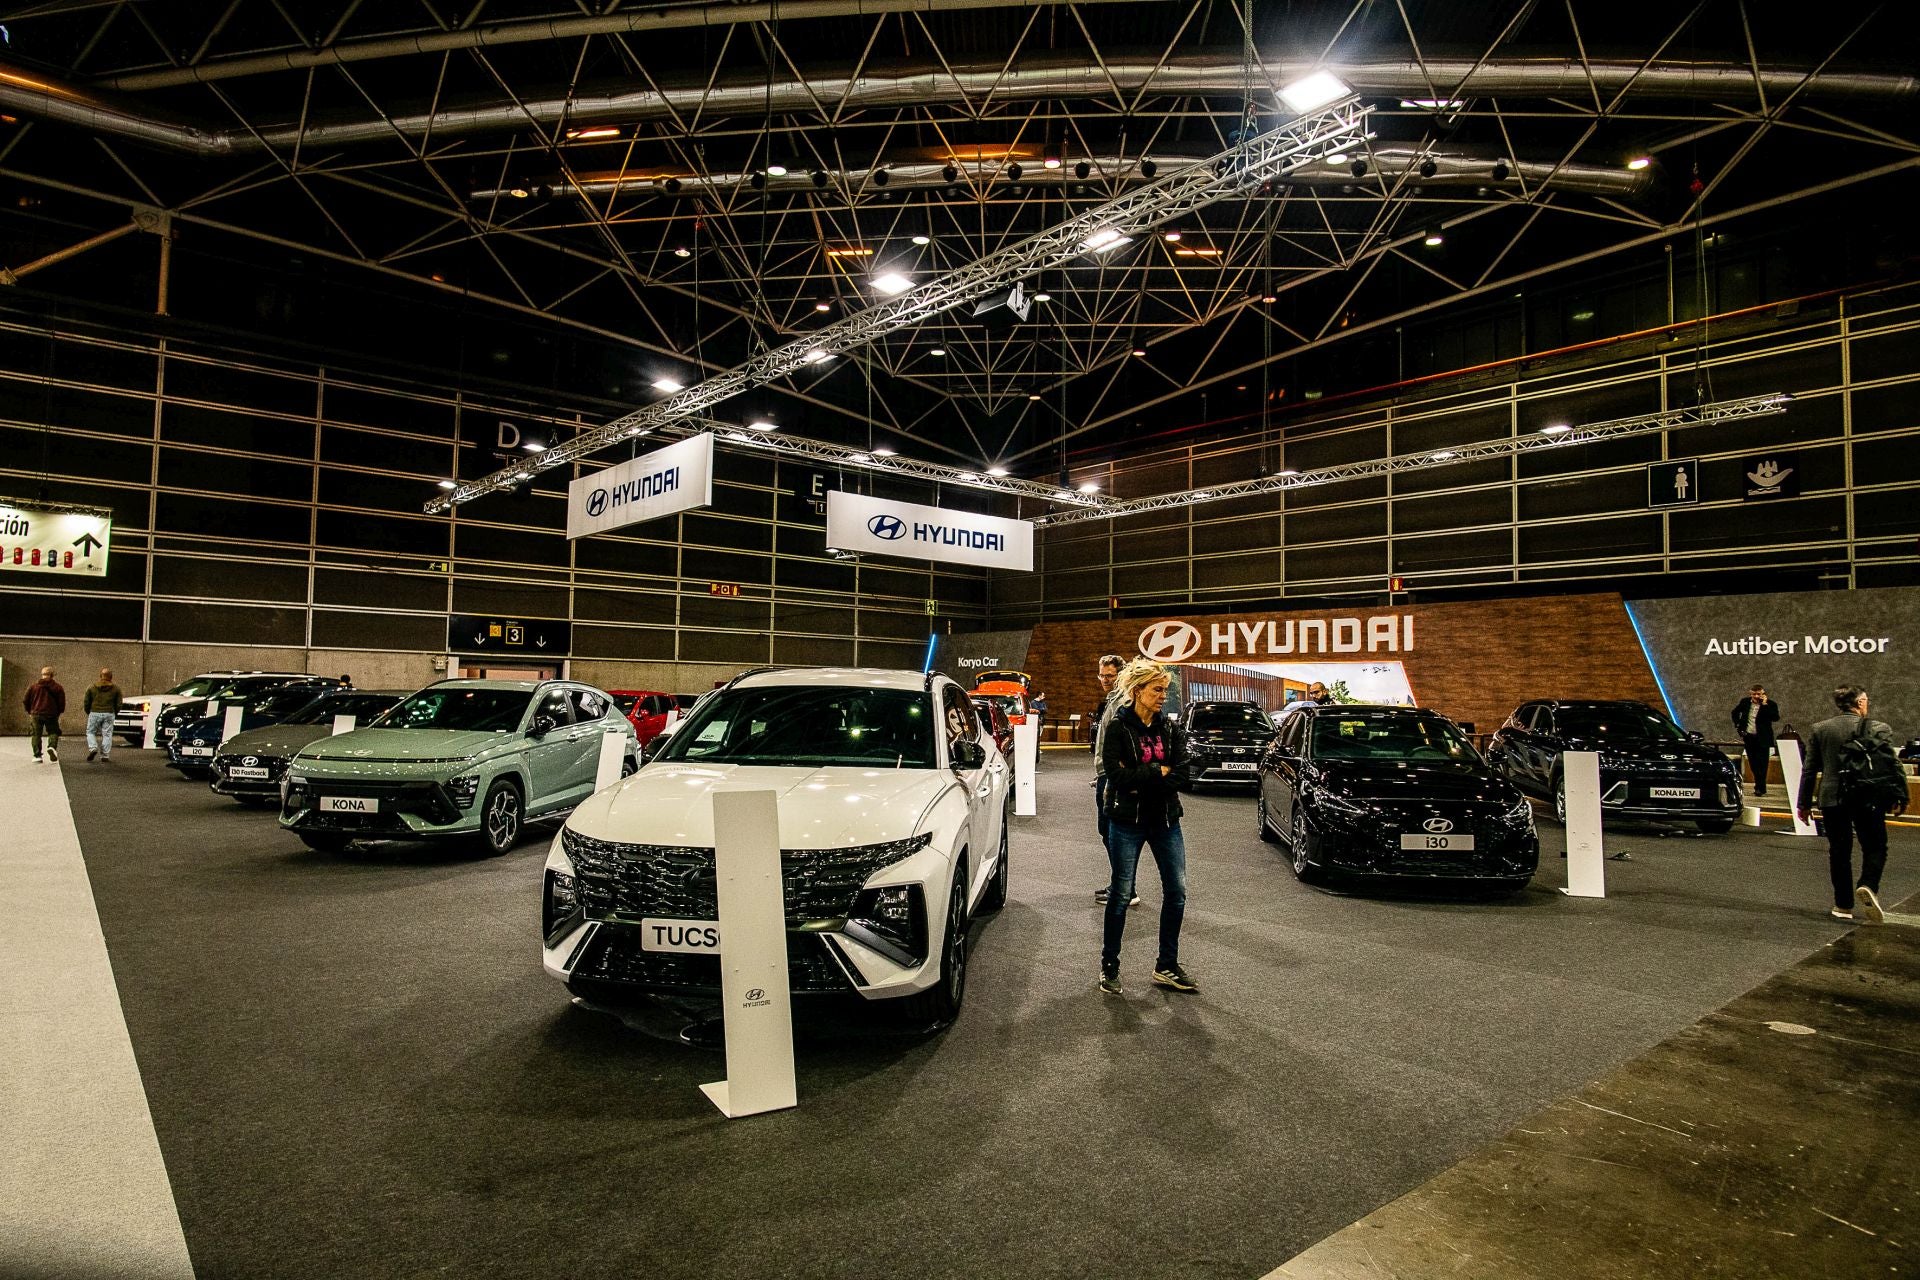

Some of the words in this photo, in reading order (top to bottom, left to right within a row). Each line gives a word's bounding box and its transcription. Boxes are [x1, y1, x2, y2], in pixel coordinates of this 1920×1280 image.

[497, 421, 520, 448] D
[612, 466, 680, 508] HYUNDAI
[812, 473, 824, 497] E
[819, 503, 824, 513] 1
[913, 522, 1004, 552] HYUNDAI
[510, 628, 520, 642] 3
[1211, 615, 1414, 655] HYUNDAI
[1704, 636, 1799, 656] Autiber
[1804, 635, 1889, 654] Motor
[958, 657, 982, 669] Koryo
[982, 656, 999, 667] Car
[241, 769, 267, 777] Fastback
[1654, 789, 1678, 797] KONA
[1678, 789, 1696, 797] HEV
[332, 799, 366, 811] KONA
[1425, 836, 1449, 849] i30
[651, 925, 721, 948] TUCS
[742, 999, 771, 1009] HYUNDAI
